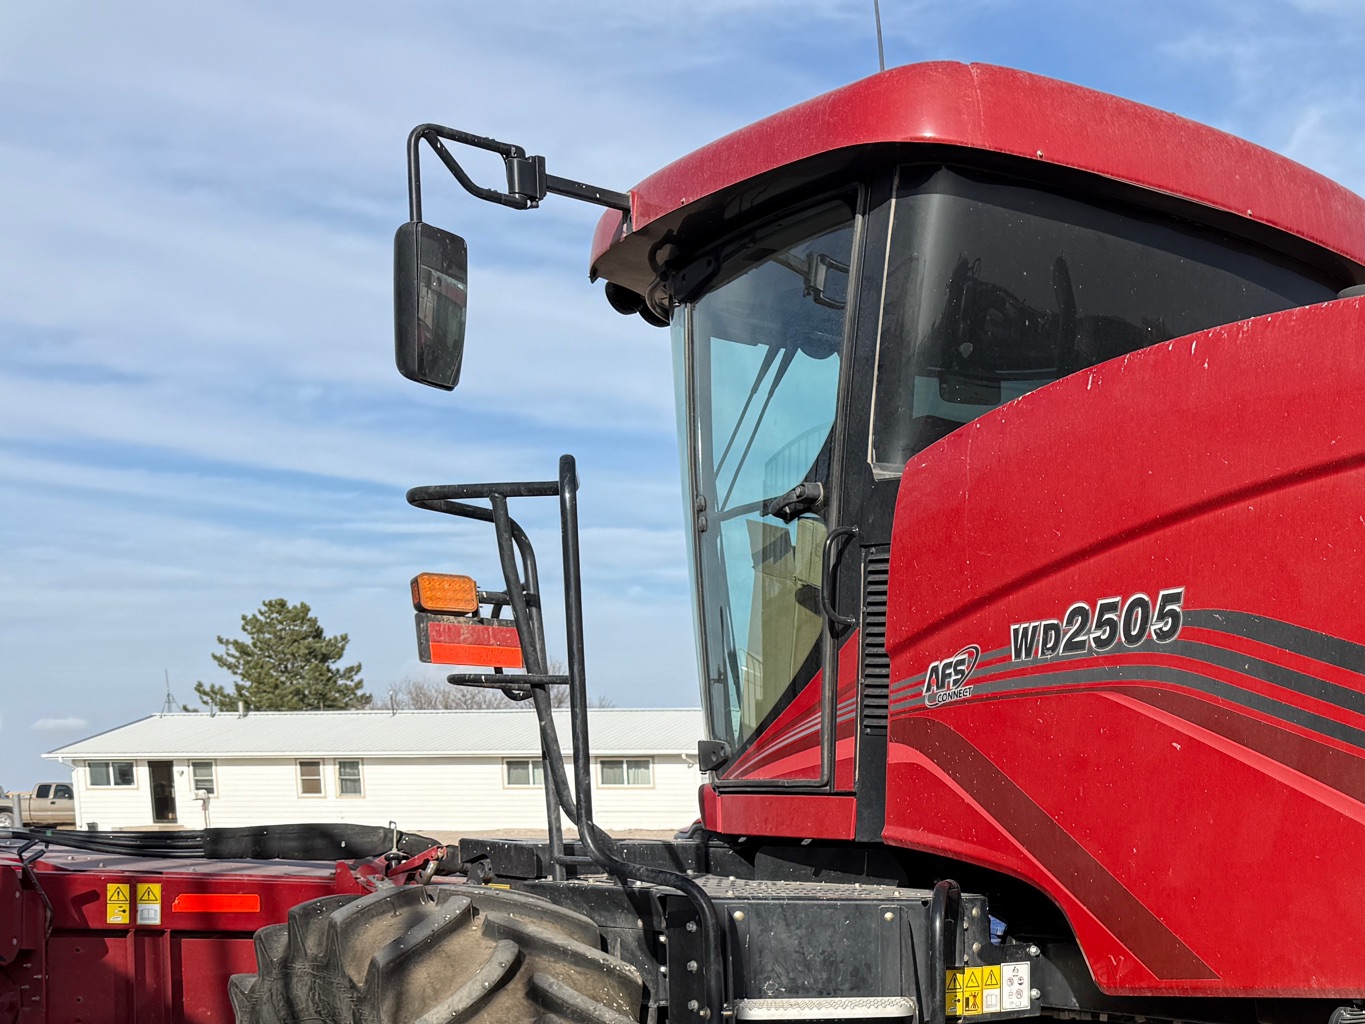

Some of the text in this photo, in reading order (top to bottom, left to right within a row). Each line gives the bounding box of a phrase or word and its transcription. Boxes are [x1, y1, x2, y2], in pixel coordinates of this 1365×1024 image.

[1010, 586, 1186, 662] WD2505
[923, 654, 970, 696] AFS
[936, 686, 974, 705] CONNECT
